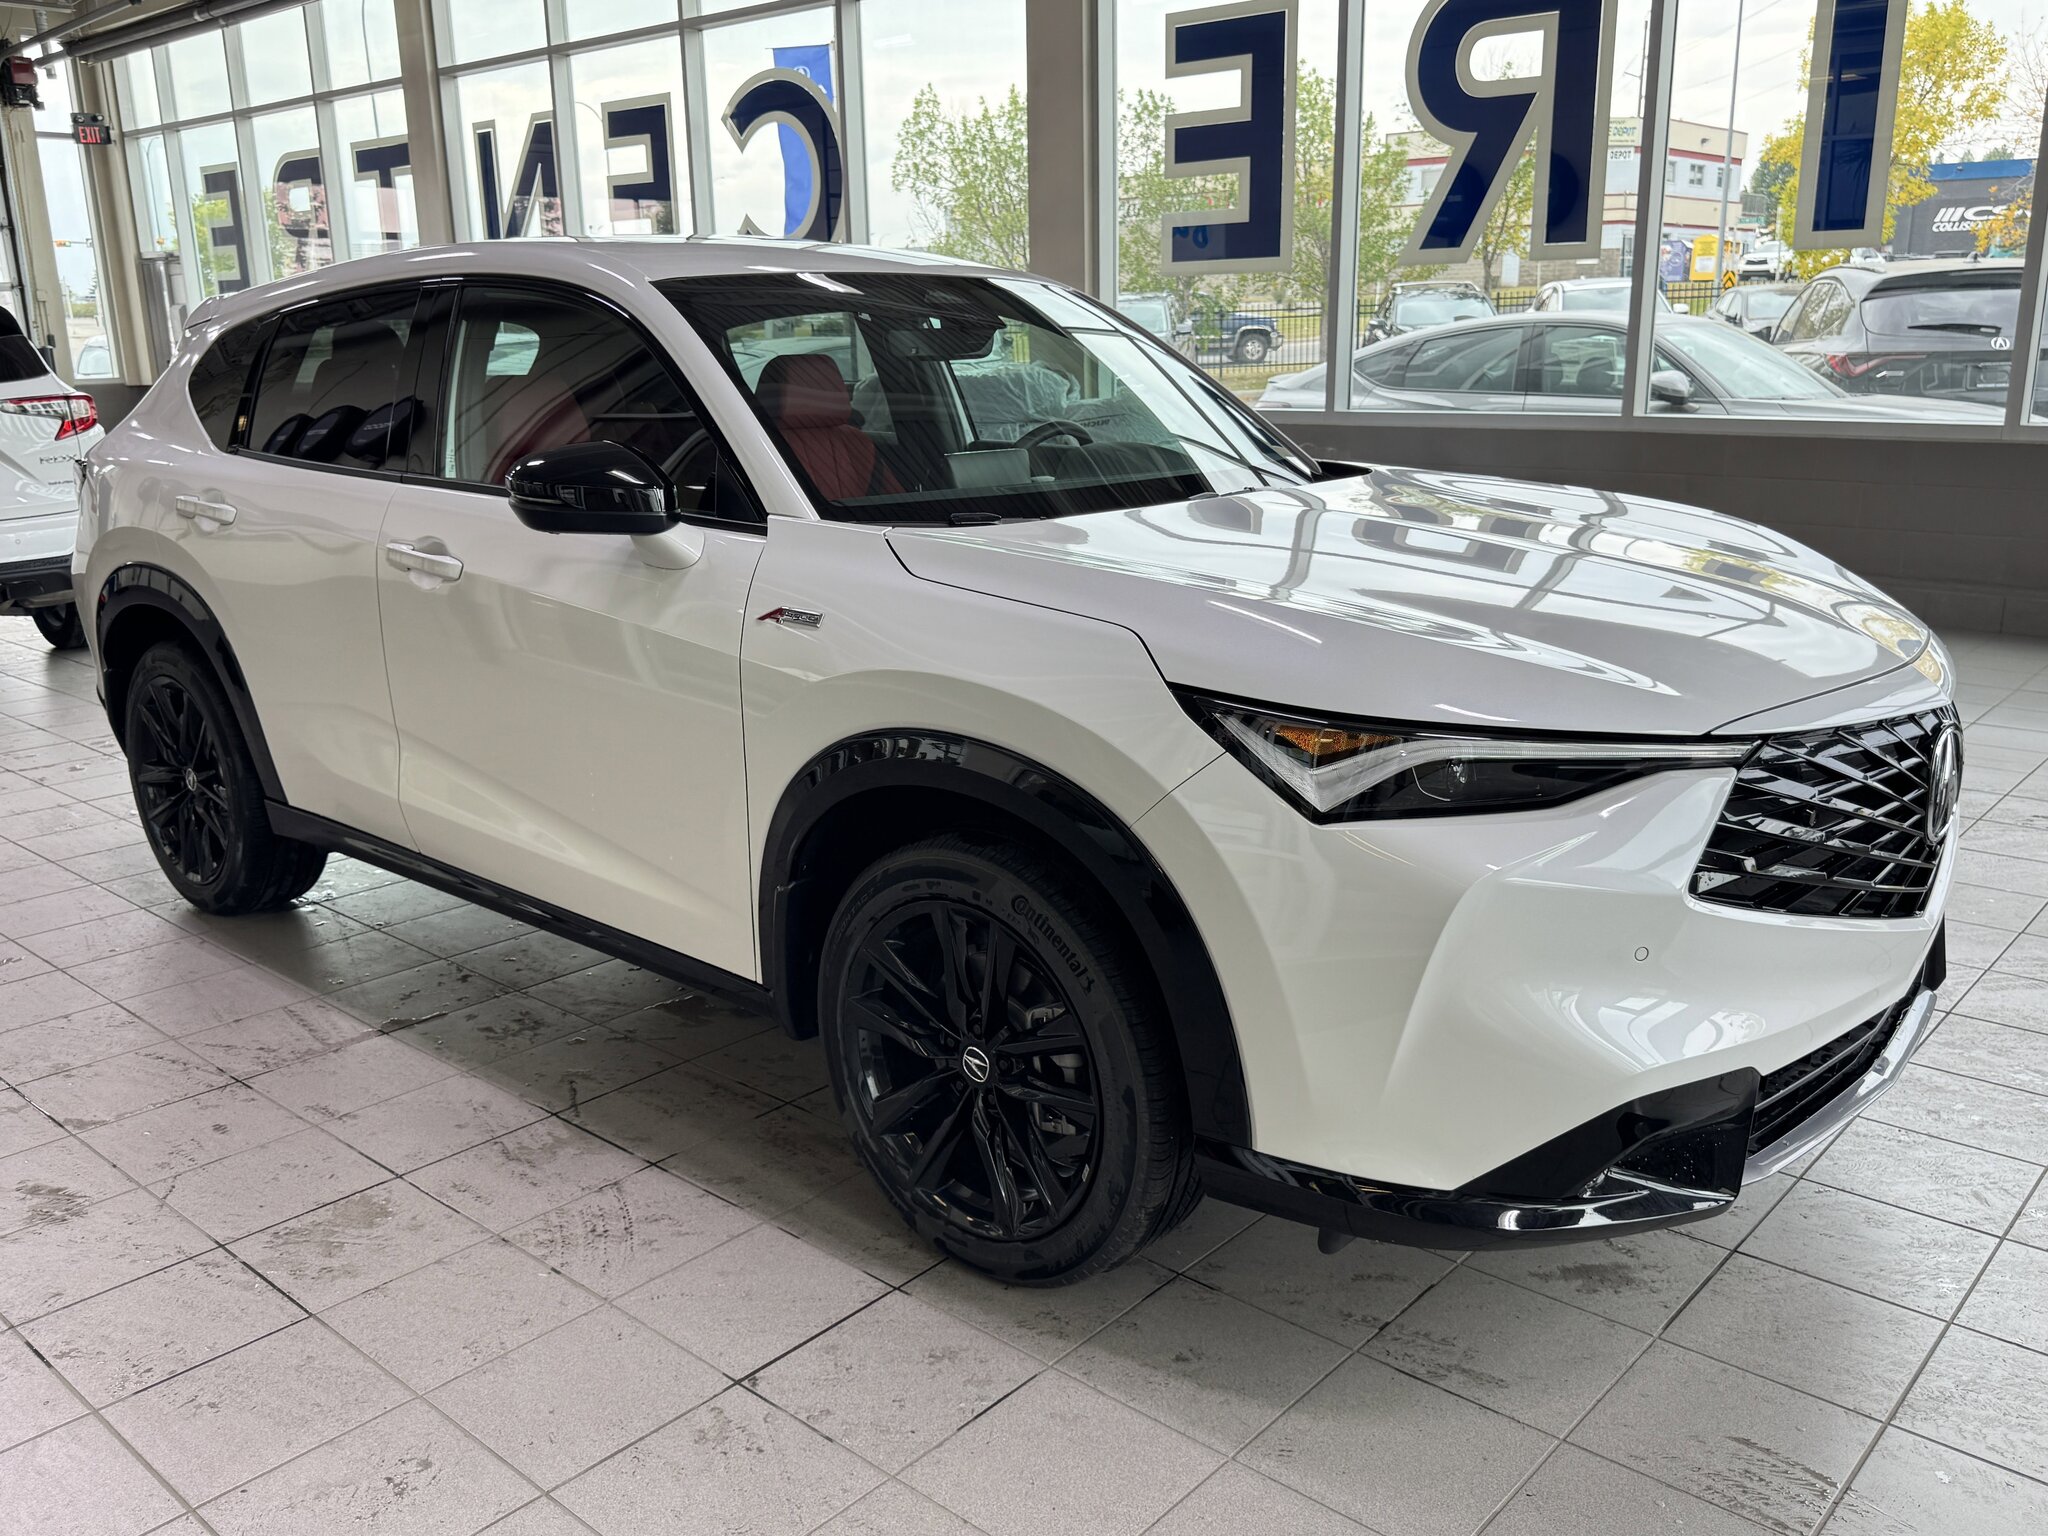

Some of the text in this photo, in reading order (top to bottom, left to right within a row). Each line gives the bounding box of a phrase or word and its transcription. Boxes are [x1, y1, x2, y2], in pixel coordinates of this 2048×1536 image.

[78, 126, 101, 144] EXIT
[1610, 150, 1632, 160] DEPOT
[1011, 894, 1090, 978] Continental
